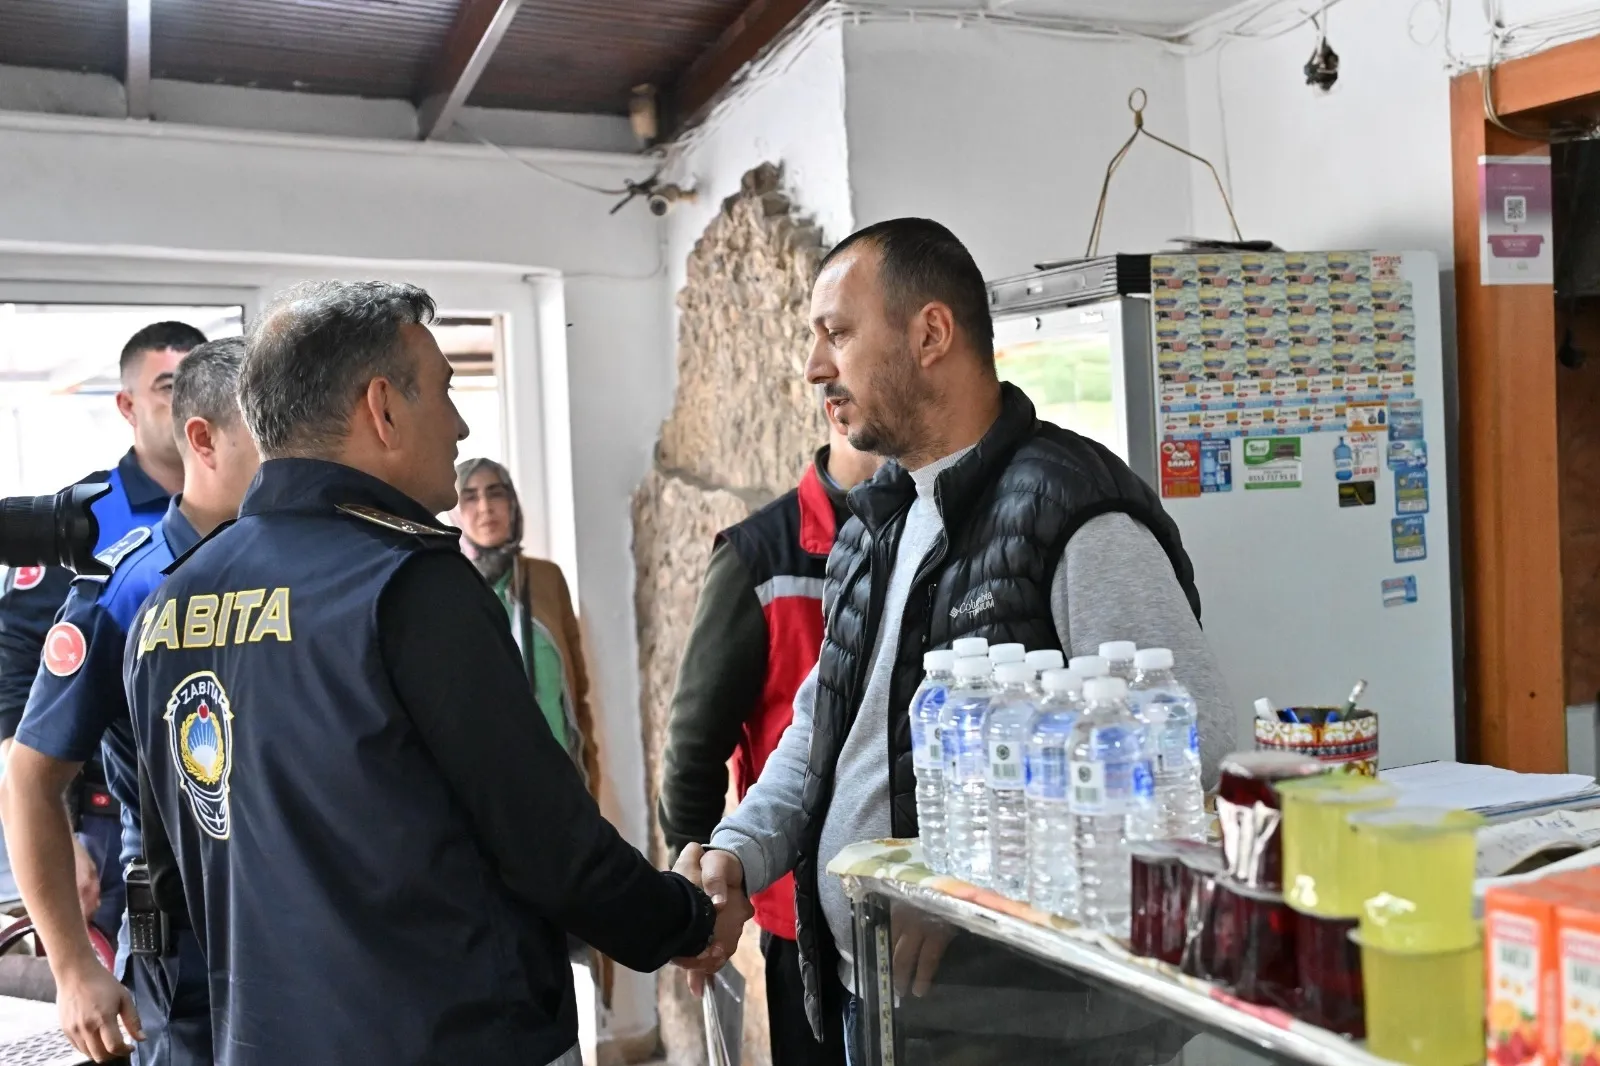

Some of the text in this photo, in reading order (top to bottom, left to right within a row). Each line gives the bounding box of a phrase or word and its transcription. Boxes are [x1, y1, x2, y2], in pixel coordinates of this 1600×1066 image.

[960, 591, 993, 613] Columbia
[137, 588, 292, 660] ZABITA
[180, 681, 219, 705] ZABITA
